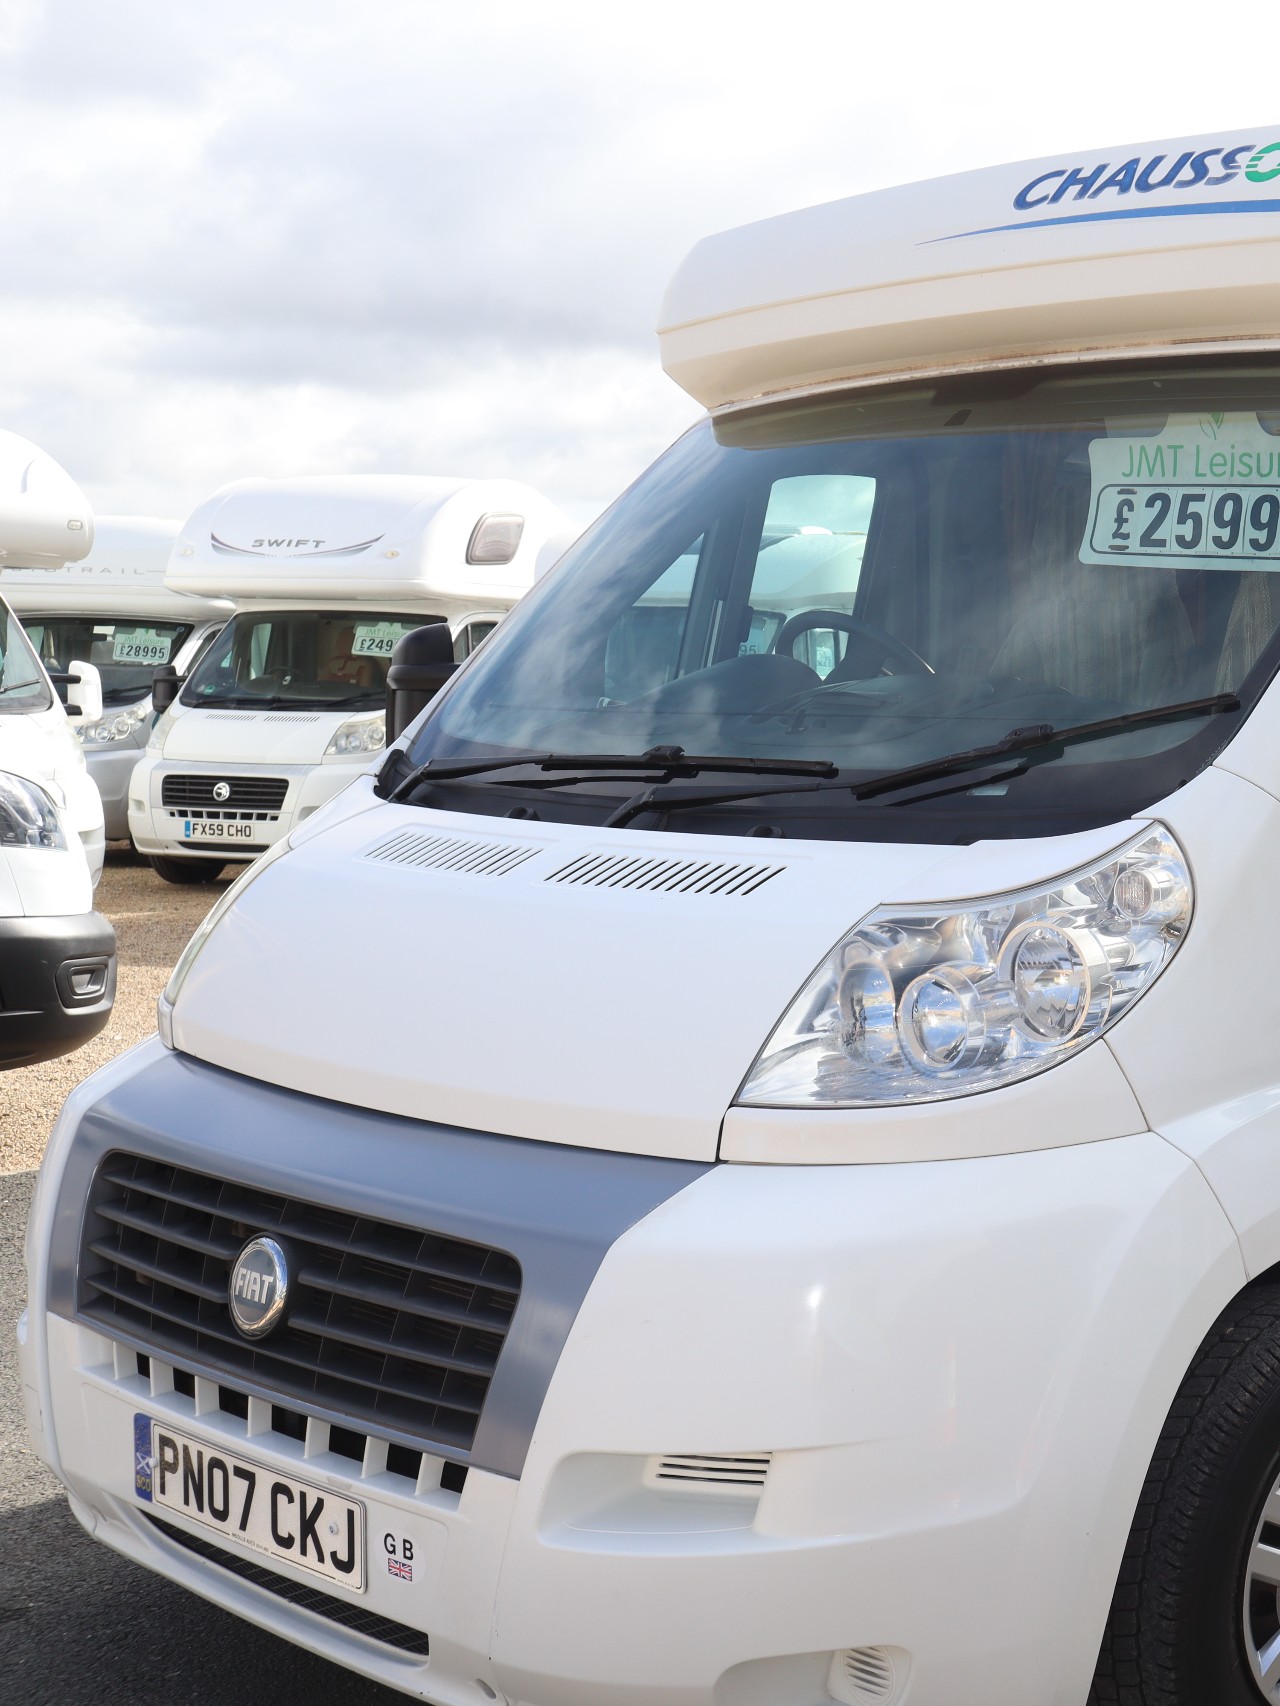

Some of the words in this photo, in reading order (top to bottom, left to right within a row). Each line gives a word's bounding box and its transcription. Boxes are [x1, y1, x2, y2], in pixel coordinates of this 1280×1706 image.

[1121, 444, 1184, 478] JMT
[252, 538, 326, 549] SWIFT
[364, 628, 381, 637] JMT
[140, 637, 166, 646] Leisure
[120, 645, 166, 659] £28995
[192, 823, 224, 836] FX59
[227, 824, 252, 838] CHO
[234, 1267, 274, 1305] FIAT
[136, 1474, 152, 1492] SCO
[158, 1433, 256, 1532] PN07
[270, 1481, 355, 1574] CKJ
